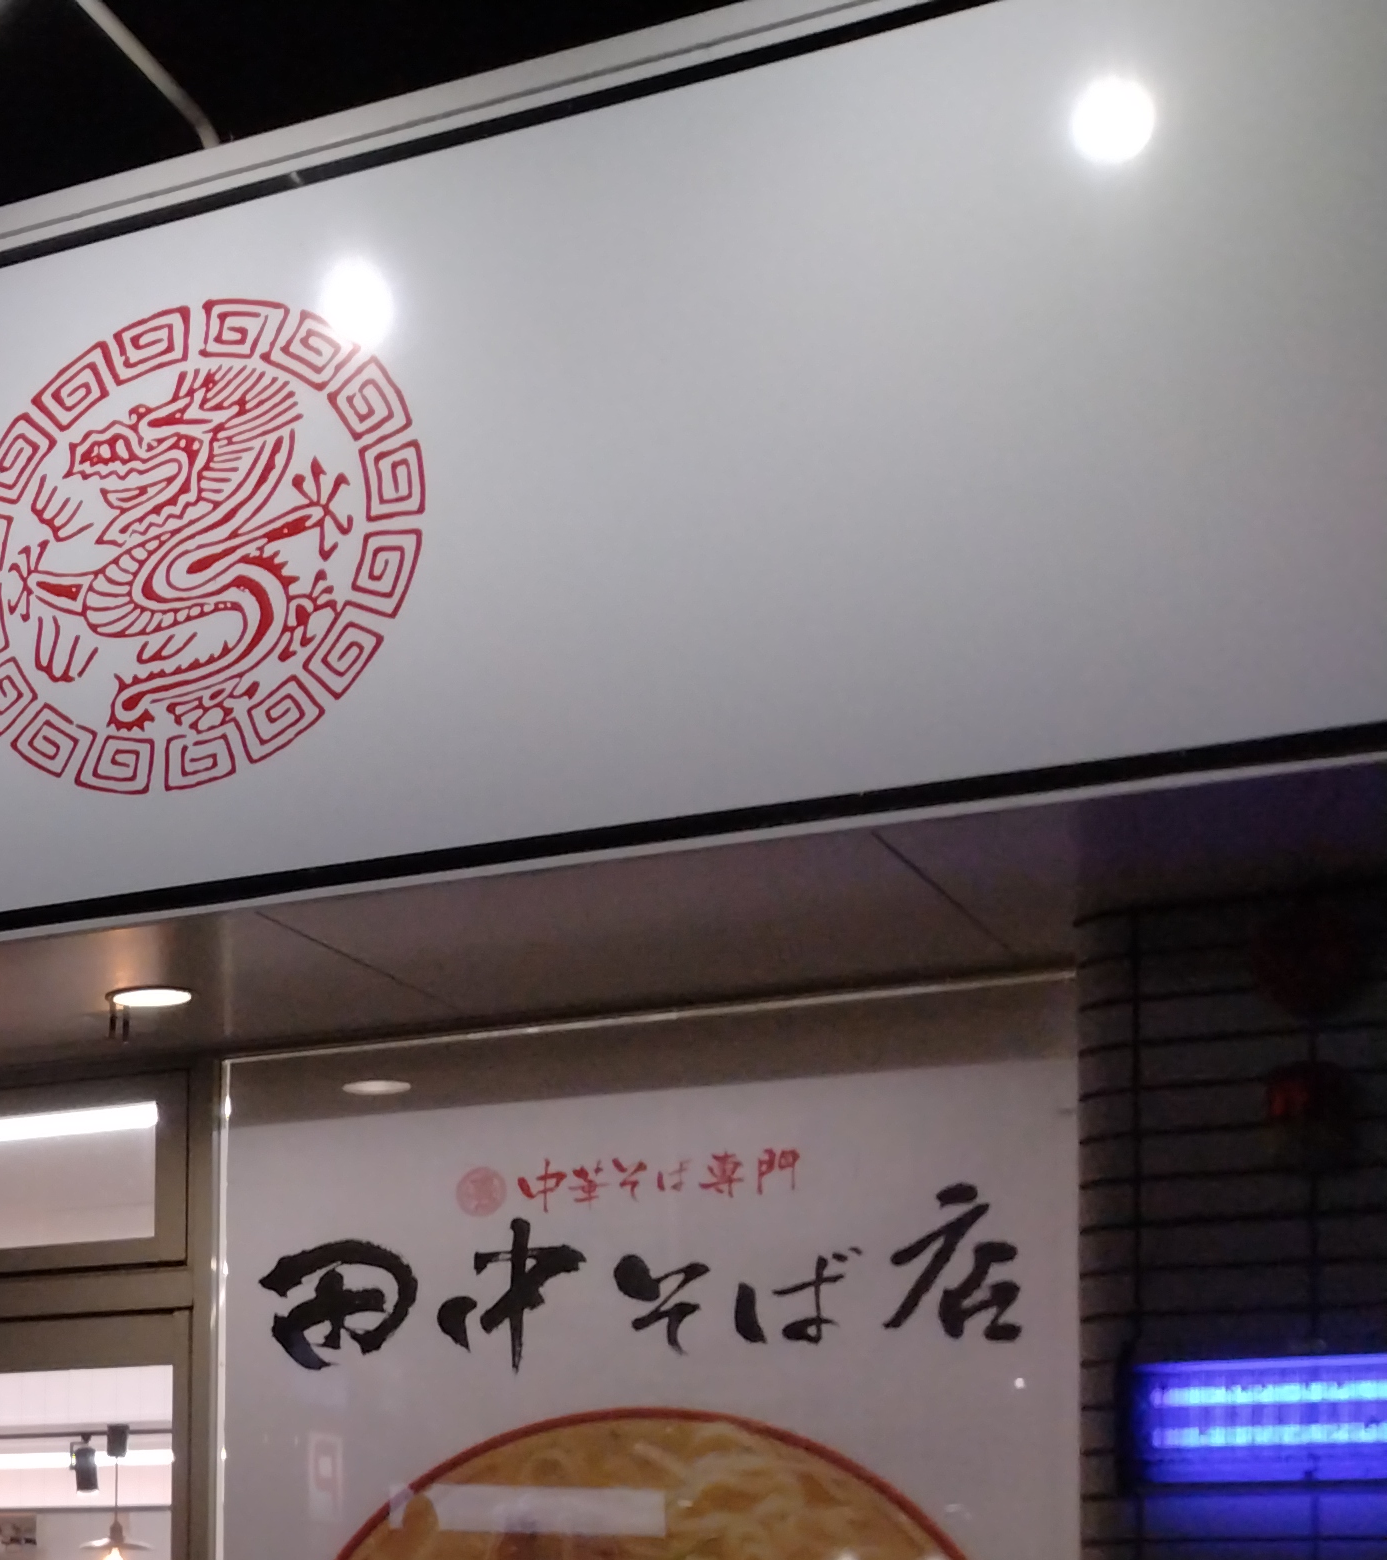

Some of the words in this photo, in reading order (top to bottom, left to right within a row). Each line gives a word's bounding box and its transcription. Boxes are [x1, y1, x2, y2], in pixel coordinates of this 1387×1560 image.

[518, 1148, 801, 1213] 中華そば専門
[257, 1183, 1023, 1375] 田中そば店
